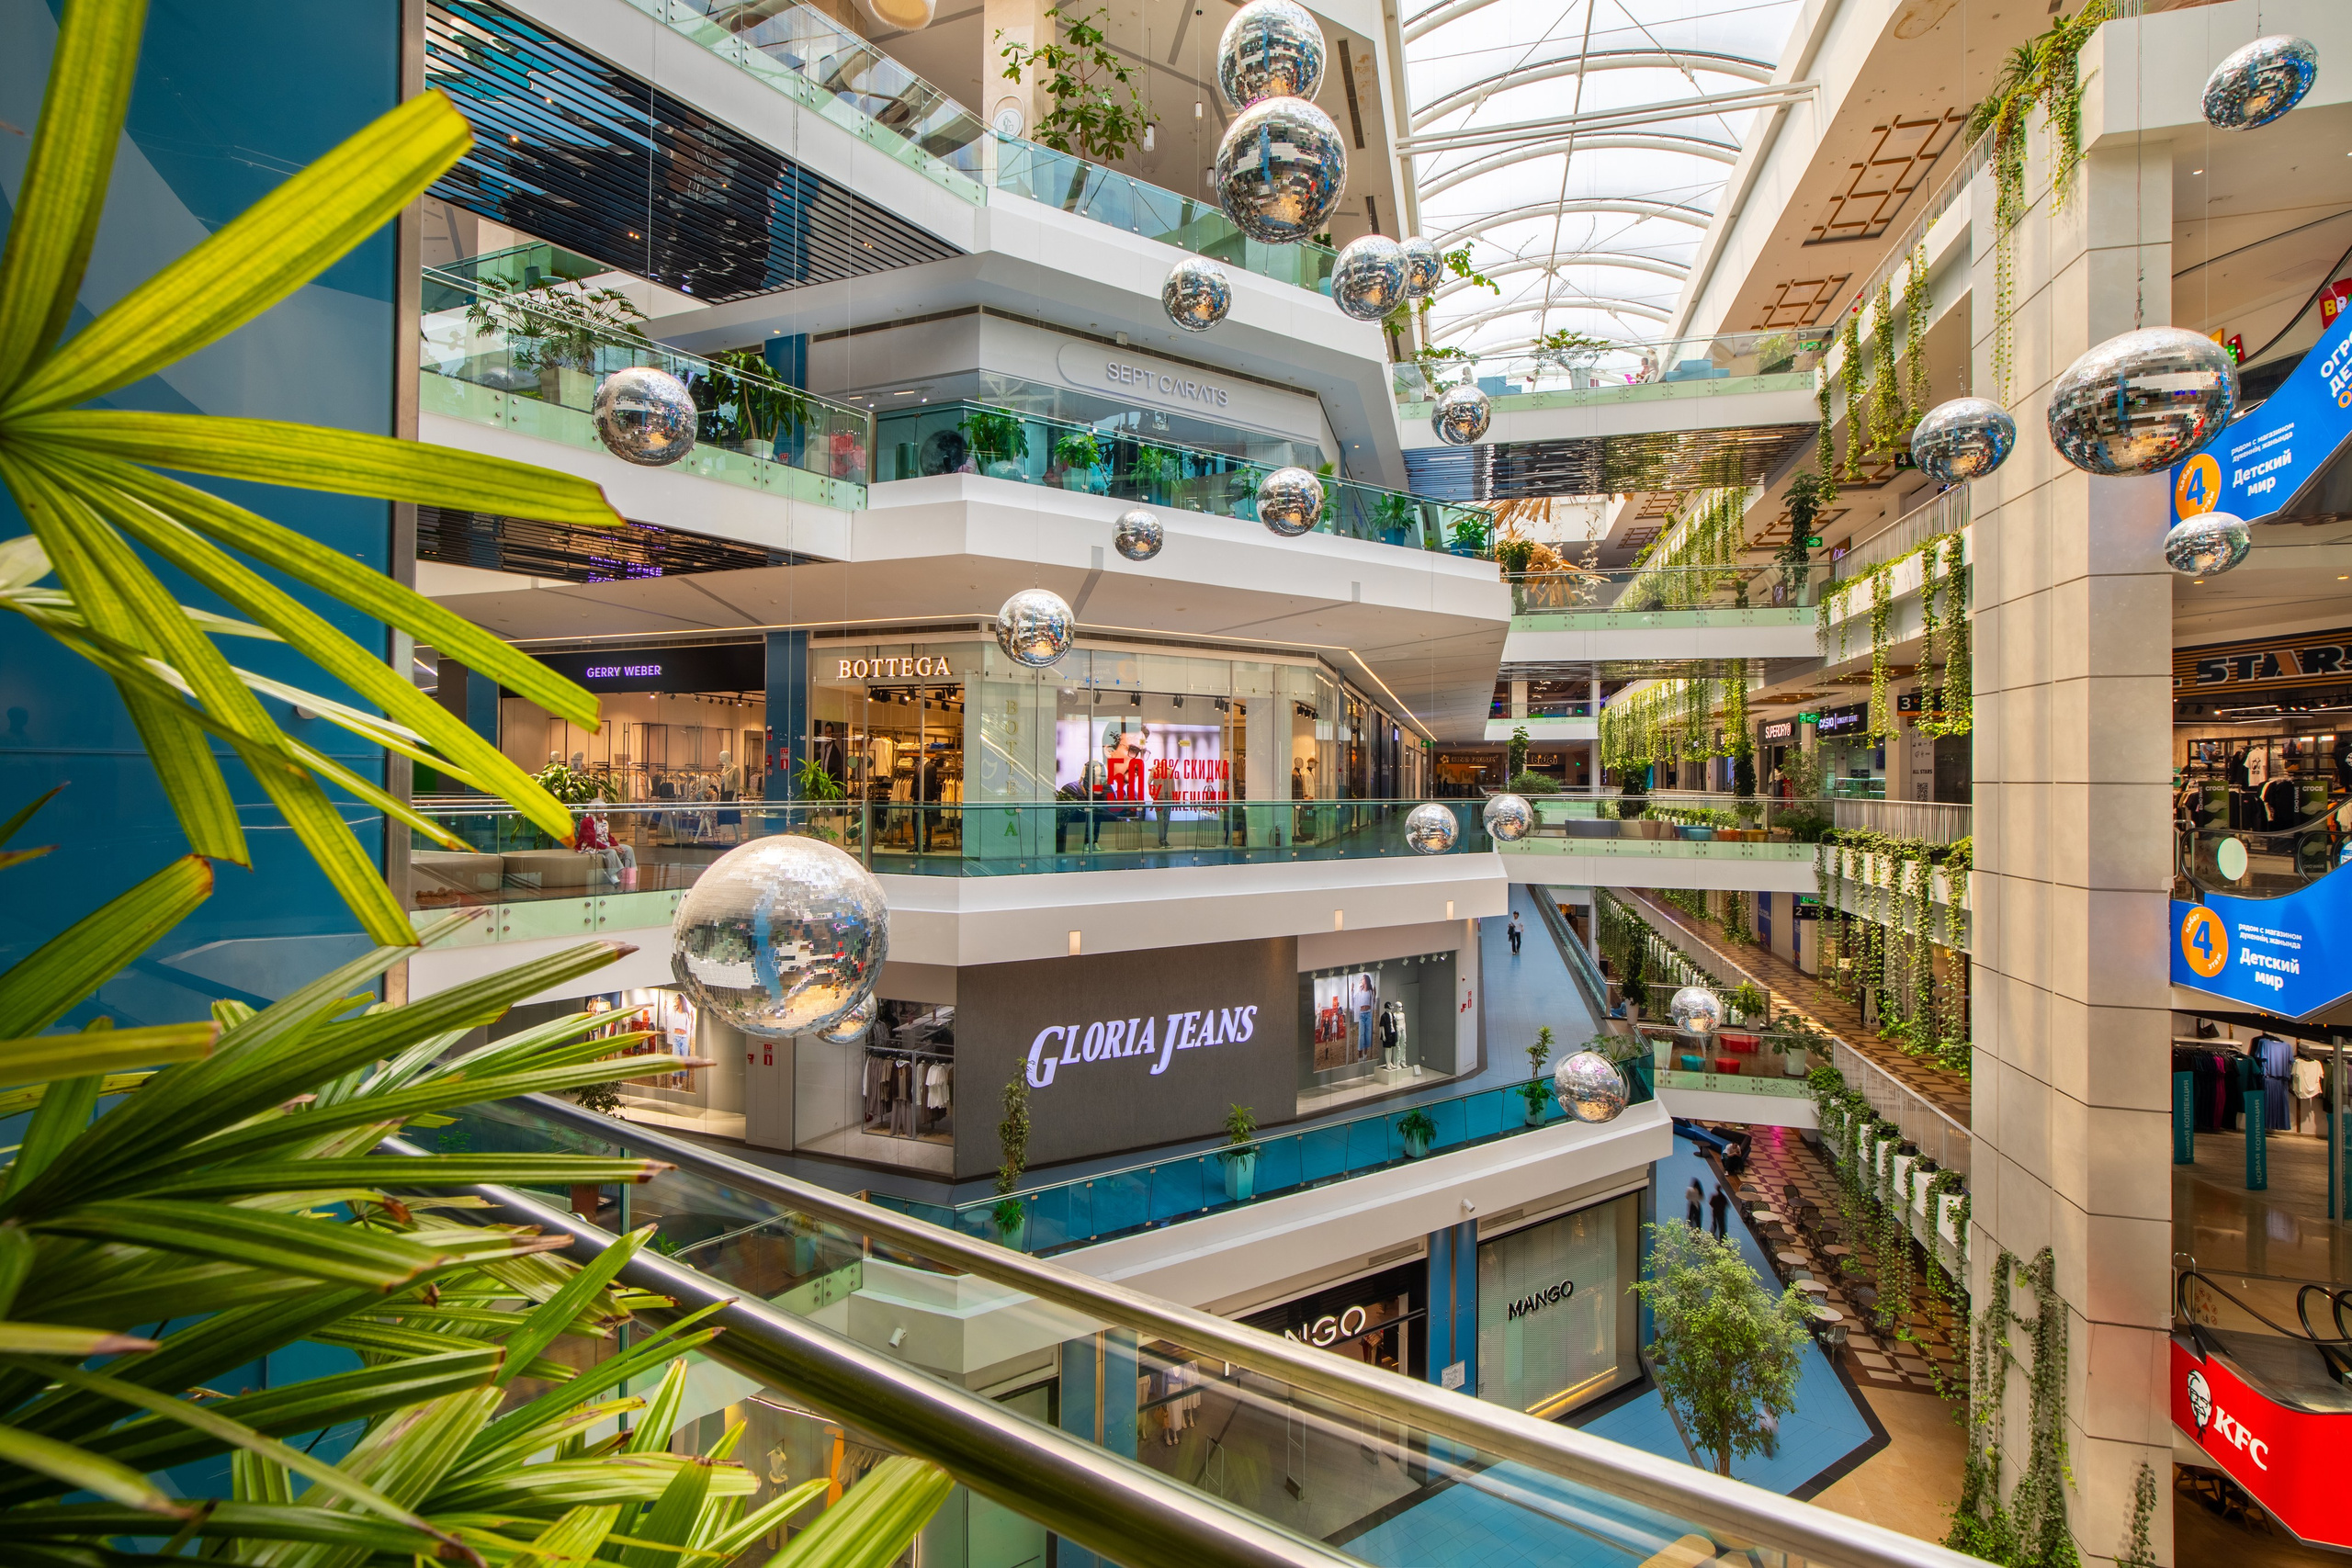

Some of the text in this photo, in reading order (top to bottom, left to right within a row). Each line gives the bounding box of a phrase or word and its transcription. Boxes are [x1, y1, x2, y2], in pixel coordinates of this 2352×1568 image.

[1106, 362, 1228, 407] SEPT CARATS
[2231, 441, 2252, 457] рядом
[2257, 422, 2295, 443] магазином
[2261, 431, 2293, 450] жанында
[1897, 453, 1908, 467] 4
[2232, 447, 2292, 489] Детский
[2186, 467, 2206, 506] 4
[2247, 476, 2277, 496] мир
[585, 664, 662, 679] GERRY WEBER
[838, 656, 951, 679] BOTTEGA
[1900, 696, 1912, 710] 3
[1818, 716, 1835, 728] CASIO
[1148, 759, 1229, 784] -30% СКИДКА
[1794, 907, 1803, 916] 2
[2192, 920, 2213, 960] 4
[2238, 923, 2259, 933] рядом
[2265, 928, 2302, 942] магазином
[2268, 937, 2301, 950] жанында
[2207, 952, 2222, 970] этаж
[2239, 946, 2300, 975] Детский
[2255, 971, 2284, 991] мир
[1025, 1005, 1258, 1089] GLORIA JEANS
[1507, 1279, 1575, 1321] MANGO
[2212, 1404, 2269, 1472] KFC
